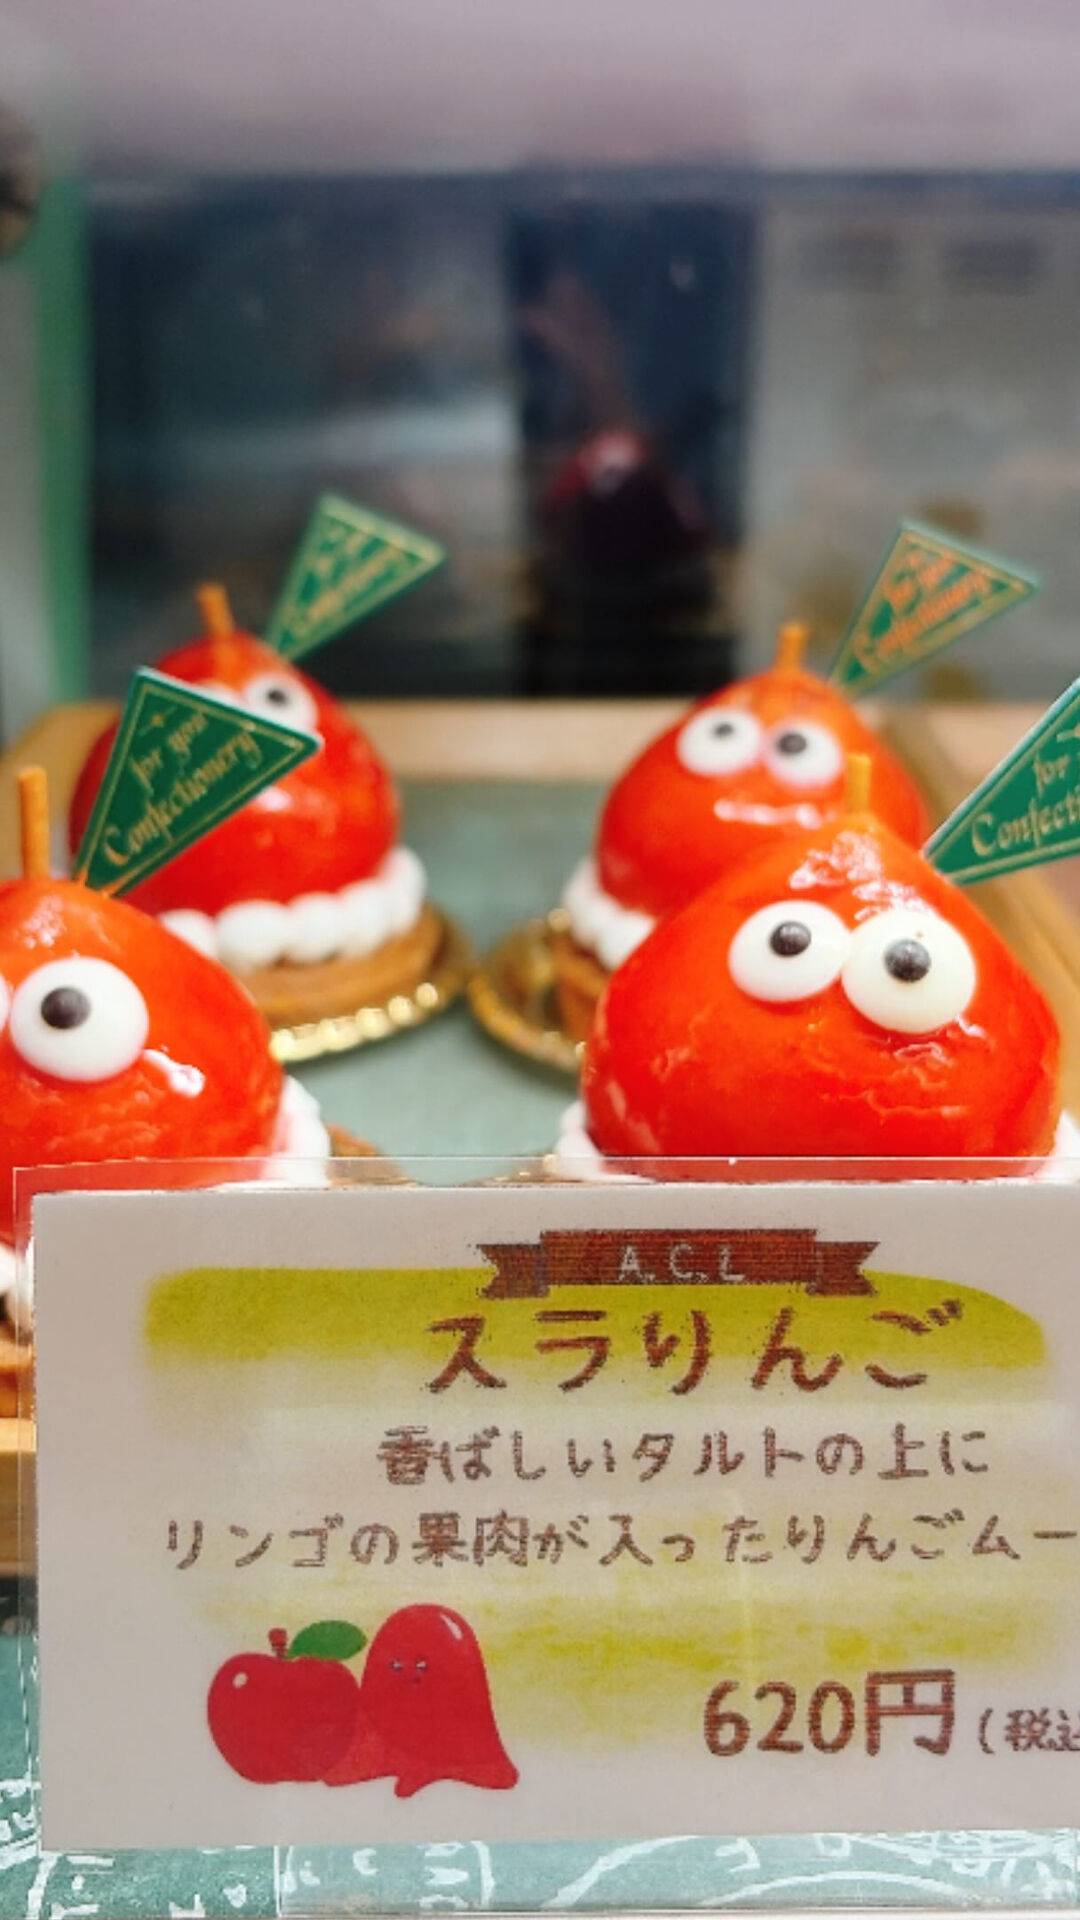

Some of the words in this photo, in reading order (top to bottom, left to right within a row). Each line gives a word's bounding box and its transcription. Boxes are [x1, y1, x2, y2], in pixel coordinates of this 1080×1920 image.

[103, 730, 262, 866] Confectionery
[130, 746, 163, 795] for
[427, 1299, 964, 1395] スラりんご
[377, 1423, 988, 1486] 香ばしいタルトの上に
[167, 1509, 1078, 1570] リンゴの果肉が入ったりんごムー
[703, 1668, 956, 1757] 620円
